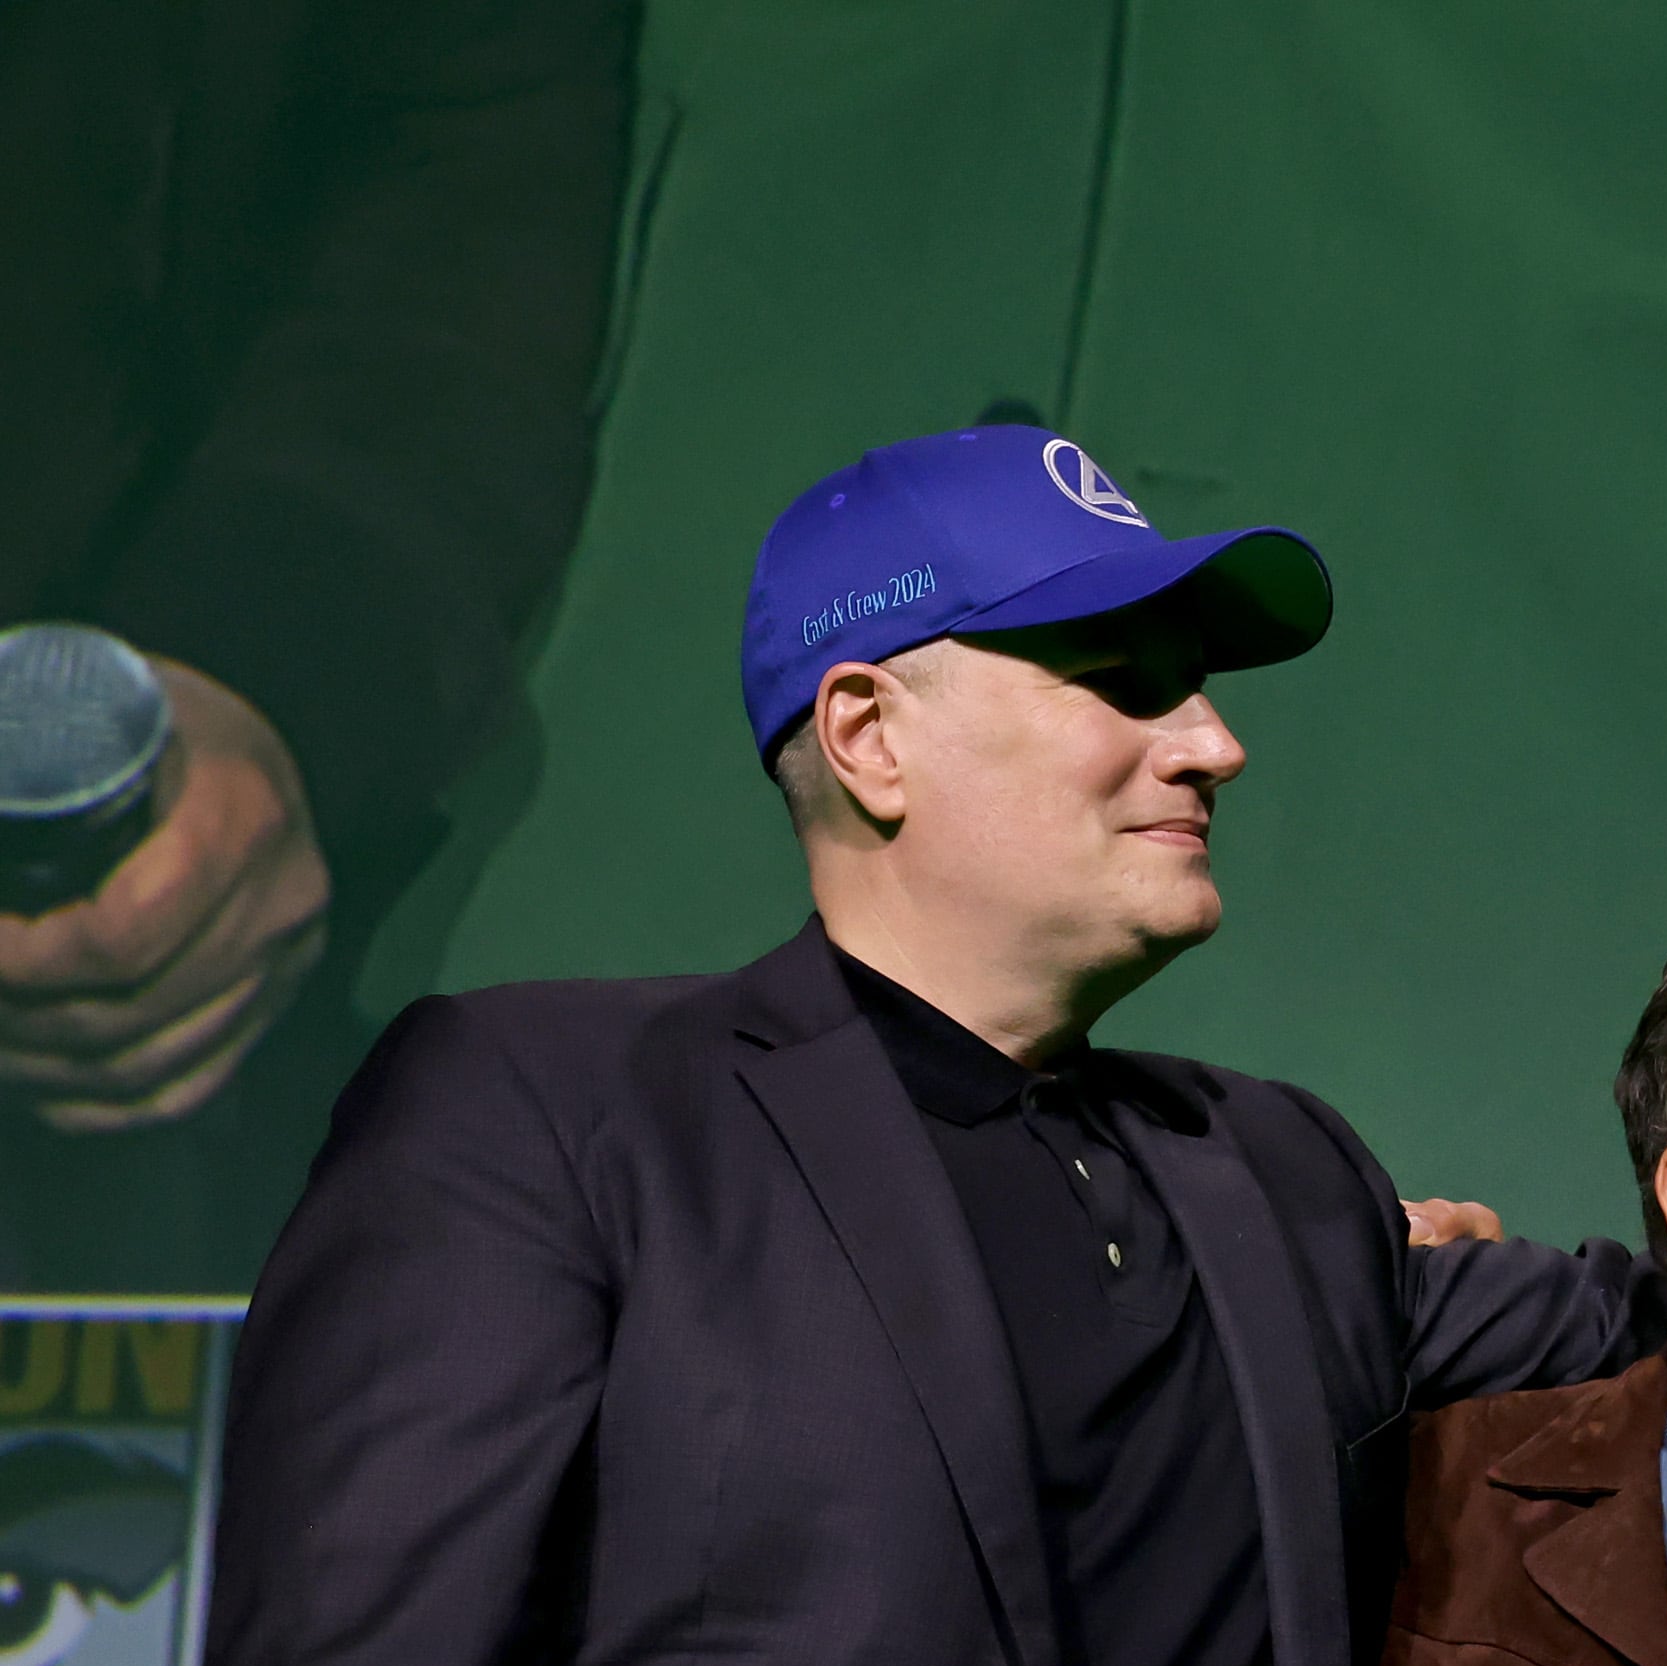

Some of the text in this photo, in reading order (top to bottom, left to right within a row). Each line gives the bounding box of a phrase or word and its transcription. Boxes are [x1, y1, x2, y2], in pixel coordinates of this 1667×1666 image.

[803, 562, 936, 646] Cast & Crew 2024
